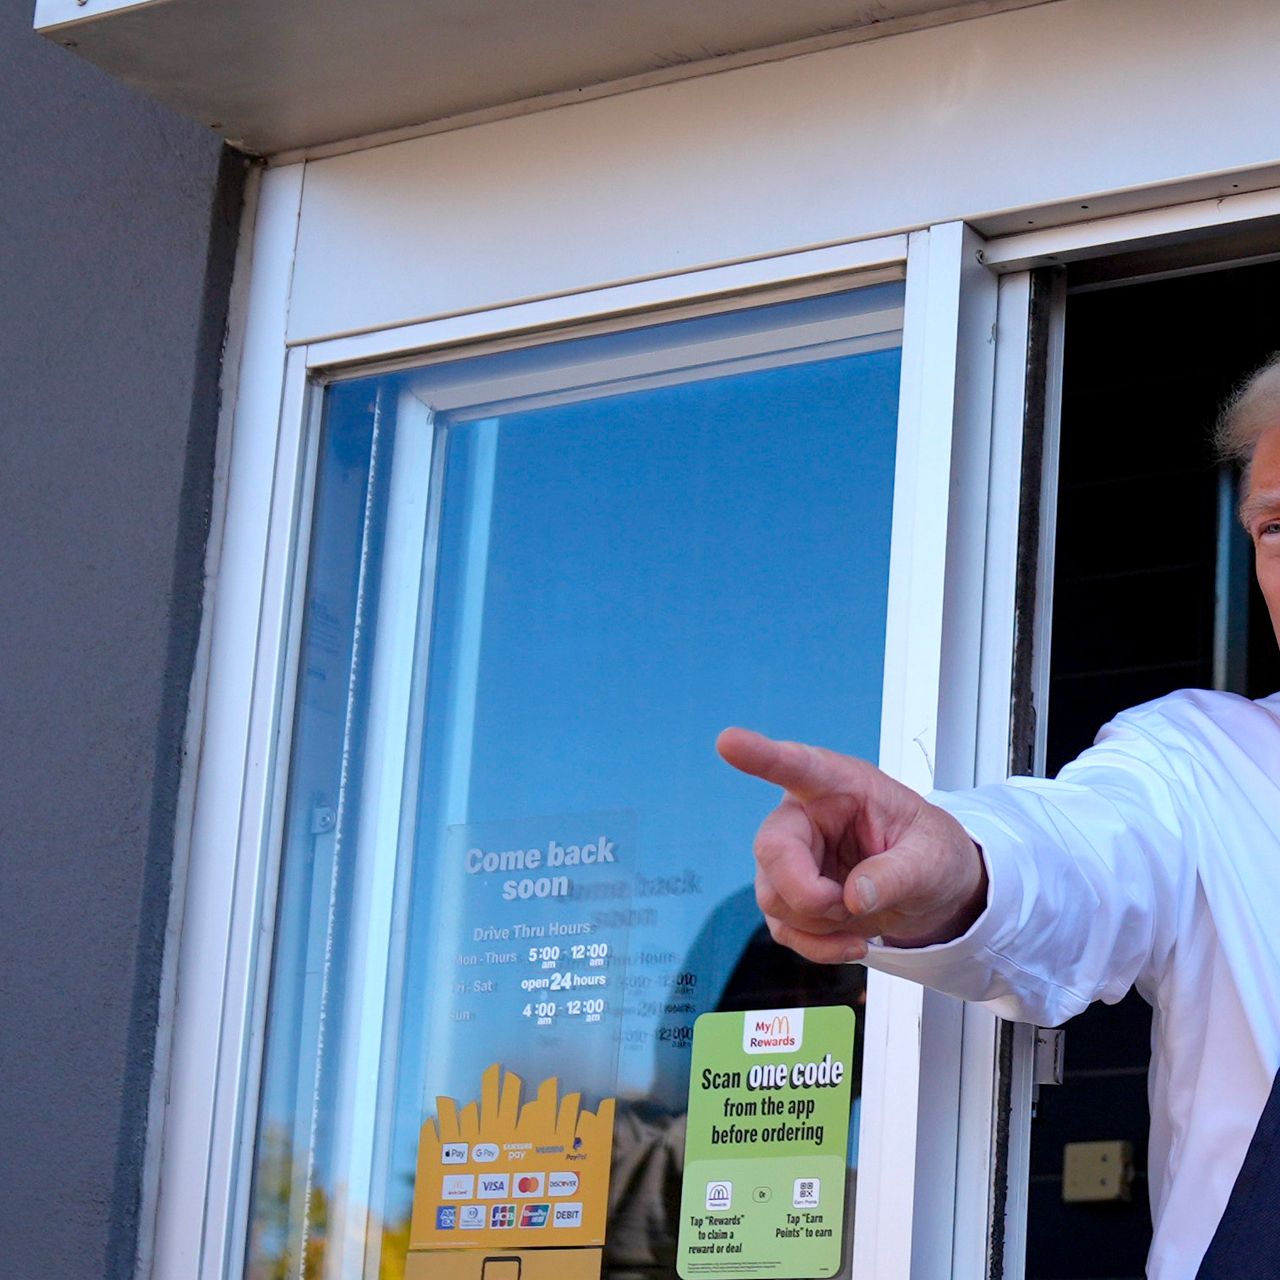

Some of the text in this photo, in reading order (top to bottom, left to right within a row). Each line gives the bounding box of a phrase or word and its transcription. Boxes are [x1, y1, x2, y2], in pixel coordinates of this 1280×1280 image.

[466, 836, 615, 874] Come back
[502, 876, 569, 900] soon
[474, 925, 509, 941] Drive
[513, 924, 545, 939] Thru
[485, 951, 517, 964] Thurs
[528, 946, 560, 961] 5:00
[570, 943, 608, 959] 12:00
[541, 958, 604, 969] am am
[473, 980, 493, 992] Sat
[521, 978, 549, 992] open
[550, 971, 572, 991] 24
[573, 974, 607, 987] hours
[522, 1002, 556, 1017] 4:00
[567, 999, 604, 1015] 12:00
[537, 1013, 601, 1025] am am
[755, 1021, 771, 1034] My
[750, 1035, 795, 1048] Rewards
[701, 1054, 844, 1090] Scan one code
[723, 1096, 815, 1119] from the app
[711, 1121, 824, 1146] before ordering
[508, 1151, 526, 1161] pay
[483, 1180, 505, 1192] VISA
[550, 1180, 577, 1189] DISCOVER
[758, 1191, 766, 1199] Or
[555, 1210, 580, 1220] DEBIT
[786, 1213, 801, 1226] Tap
[690, 1216, 704, 1228] Tap
[698, 1229, 734, 1241] to claim a
[805, 1228, 814, 1238] to
[814, 1228, 833, 1238] earn
[688, 1242, 743, 1254] reward or deal
